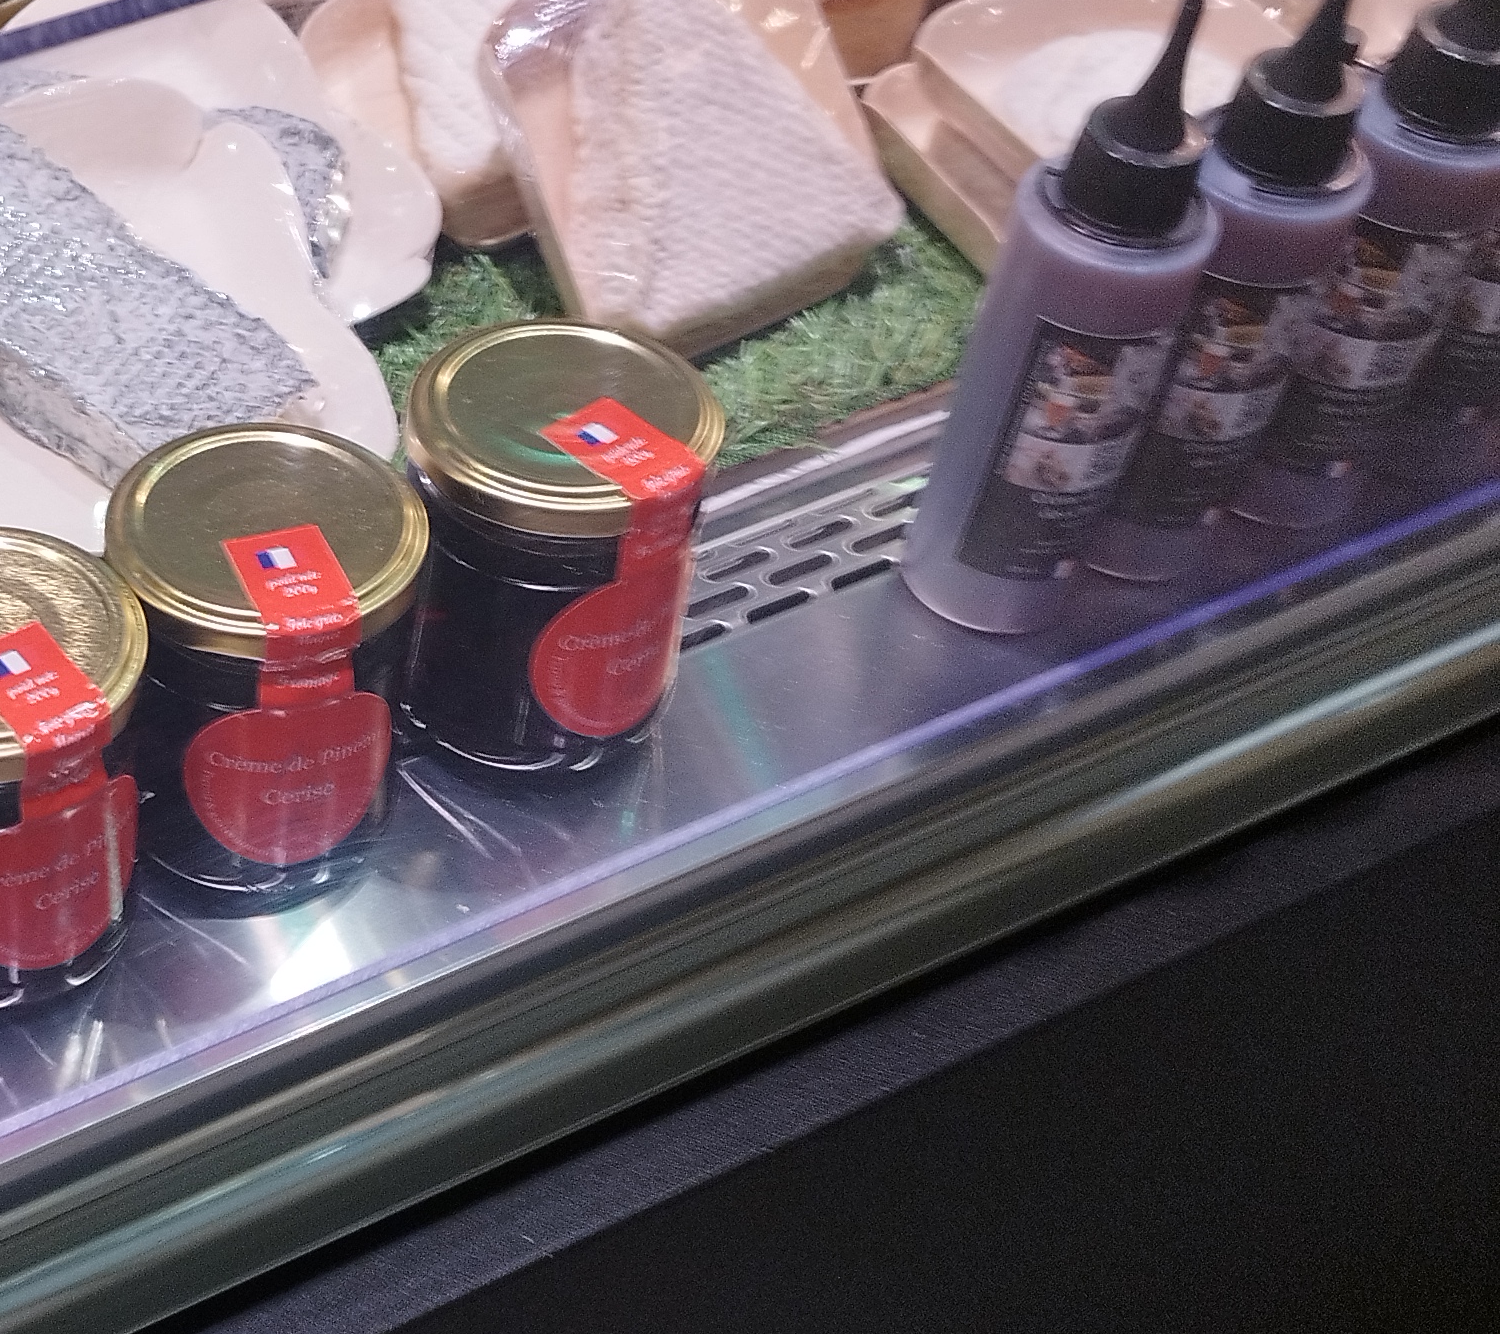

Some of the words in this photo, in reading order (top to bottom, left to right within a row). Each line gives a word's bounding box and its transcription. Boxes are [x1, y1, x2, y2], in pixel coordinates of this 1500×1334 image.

[208, 750, 283, 774] Crème
[287, 750, 317, 774] de
[261, 779, 337, 807] Cerise
